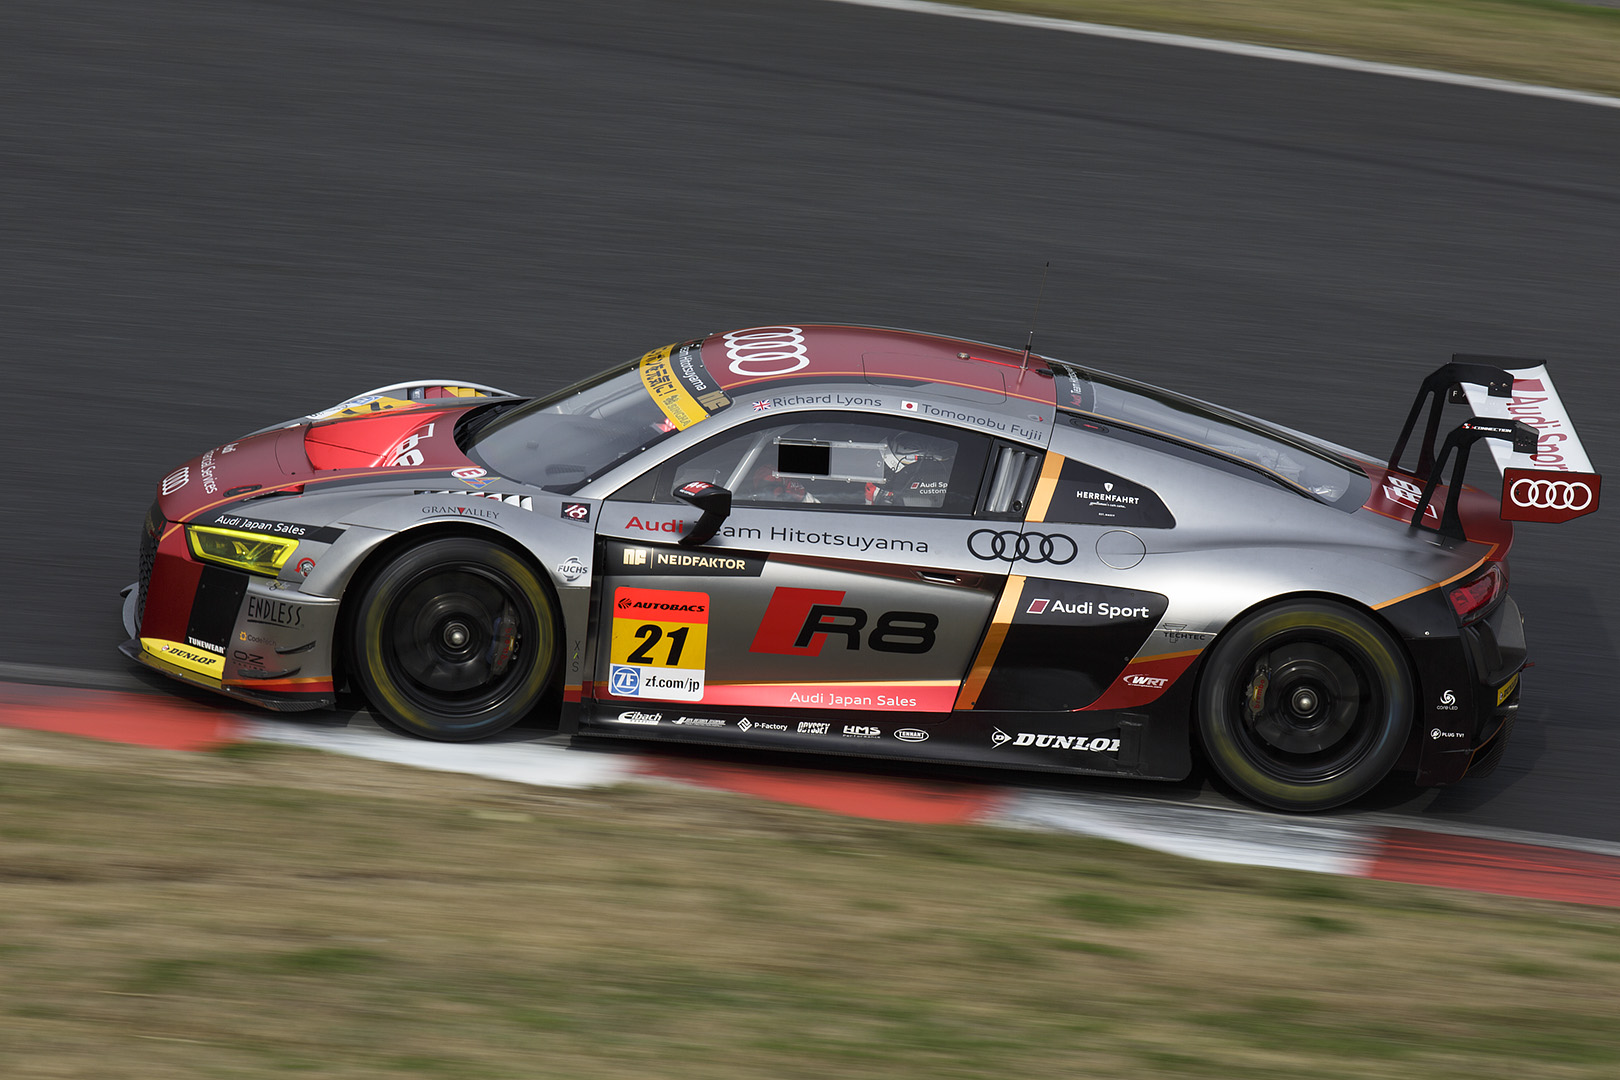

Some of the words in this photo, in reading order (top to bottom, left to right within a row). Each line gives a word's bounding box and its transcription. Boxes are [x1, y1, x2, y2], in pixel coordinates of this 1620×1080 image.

[772, 394, 831, 408] Richard
[836, 394, 882, 407] Lyons
[922, 403, 1006, 431] Tomonobu
[1011, 424, 1042, 441] Fujii
[1076, 490, 1140, 505] HERRENFAHRT
[215, 514, 241, 526] Audi
[241, 519, 273, 532] Japan
[273, 522, 306, 536] Sales
[625, 516, 684, 534] Audi
[771, 526, 929, 552] Hitotsuyama
[557, 565, 588, 575] FUCHS
[657, 553, 746, 571] NEIDFAKTOR
[248, 597, 302, 626] ENDLESS
[632, 601, 706, 613] AUTOBACS
[1051, 600, 1093, 615] Audi
[1097, 602, 1150, 619] Sport
[793, 604, 940, 655] R8
[1162, 631, 1206, 641] TECHTEC
[188, 636, 225, 655] TUNEWEAR
[626, 624, 690, 666] 21
[169, 647, 217, 666] DUNLOP
[616, 672, 635, 688] ZF
[645, 675, 700, 692] zf.com/jp
[1132, 676, 1169, 687] WRT
[789, 692, 824, 704] Audi
[829, 693, 872, 706] Japan
[876, 695, 917, 707] Sales
[618, 711, 663, 724] Eibach
[754, 722, 788, 732] P-Factory
[797, 721, 831, 735] ODYSSEY
[842, 725, 881, 736] HMS
